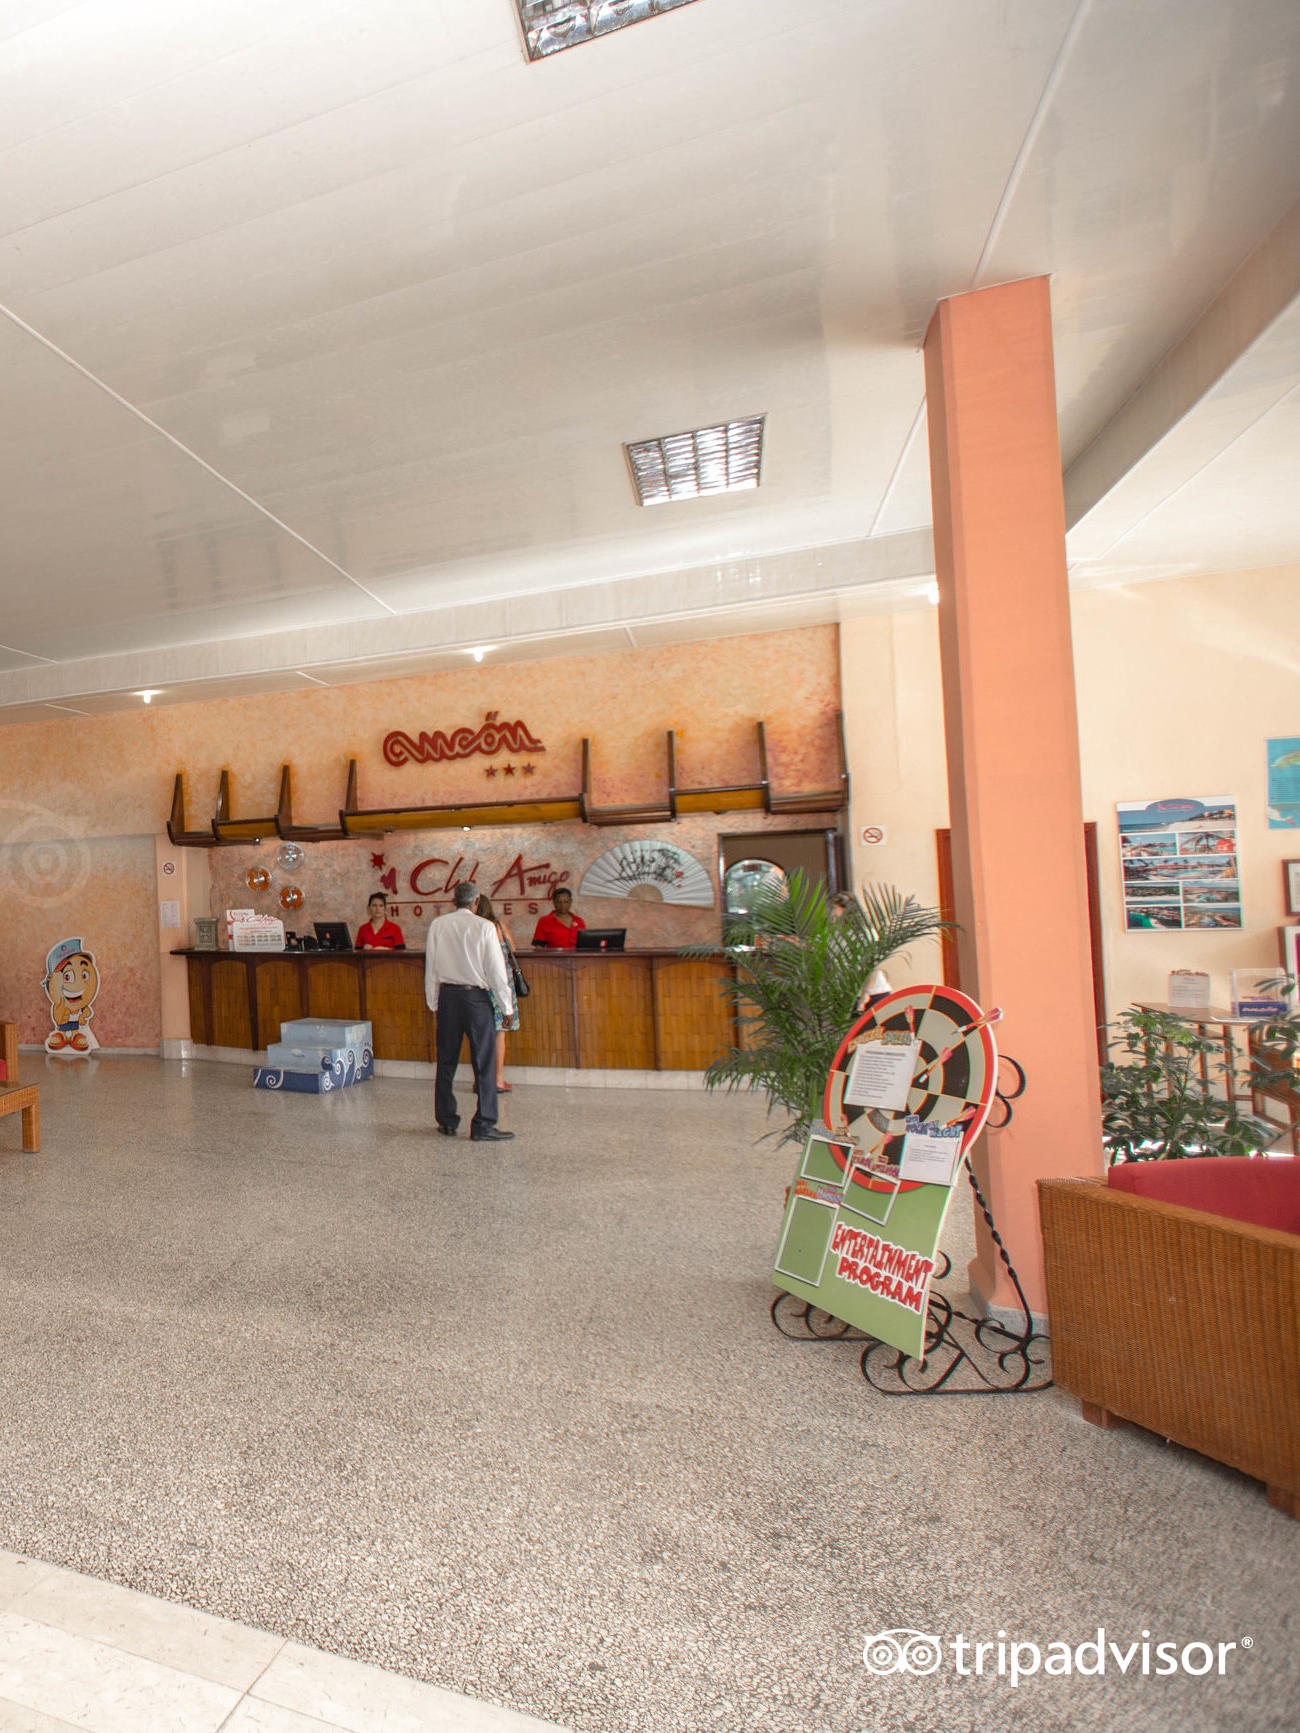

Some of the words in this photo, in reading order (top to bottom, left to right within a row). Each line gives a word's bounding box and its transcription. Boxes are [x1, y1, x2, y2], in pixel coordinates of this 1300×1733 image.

[490, 854, 570, 900] Amigo
[390, 903, 539, 917] HOTES
[832, 1224, 933, 1289] ENTERTAINMENT
[838, 1256, 922, 1312] PROGRAM
